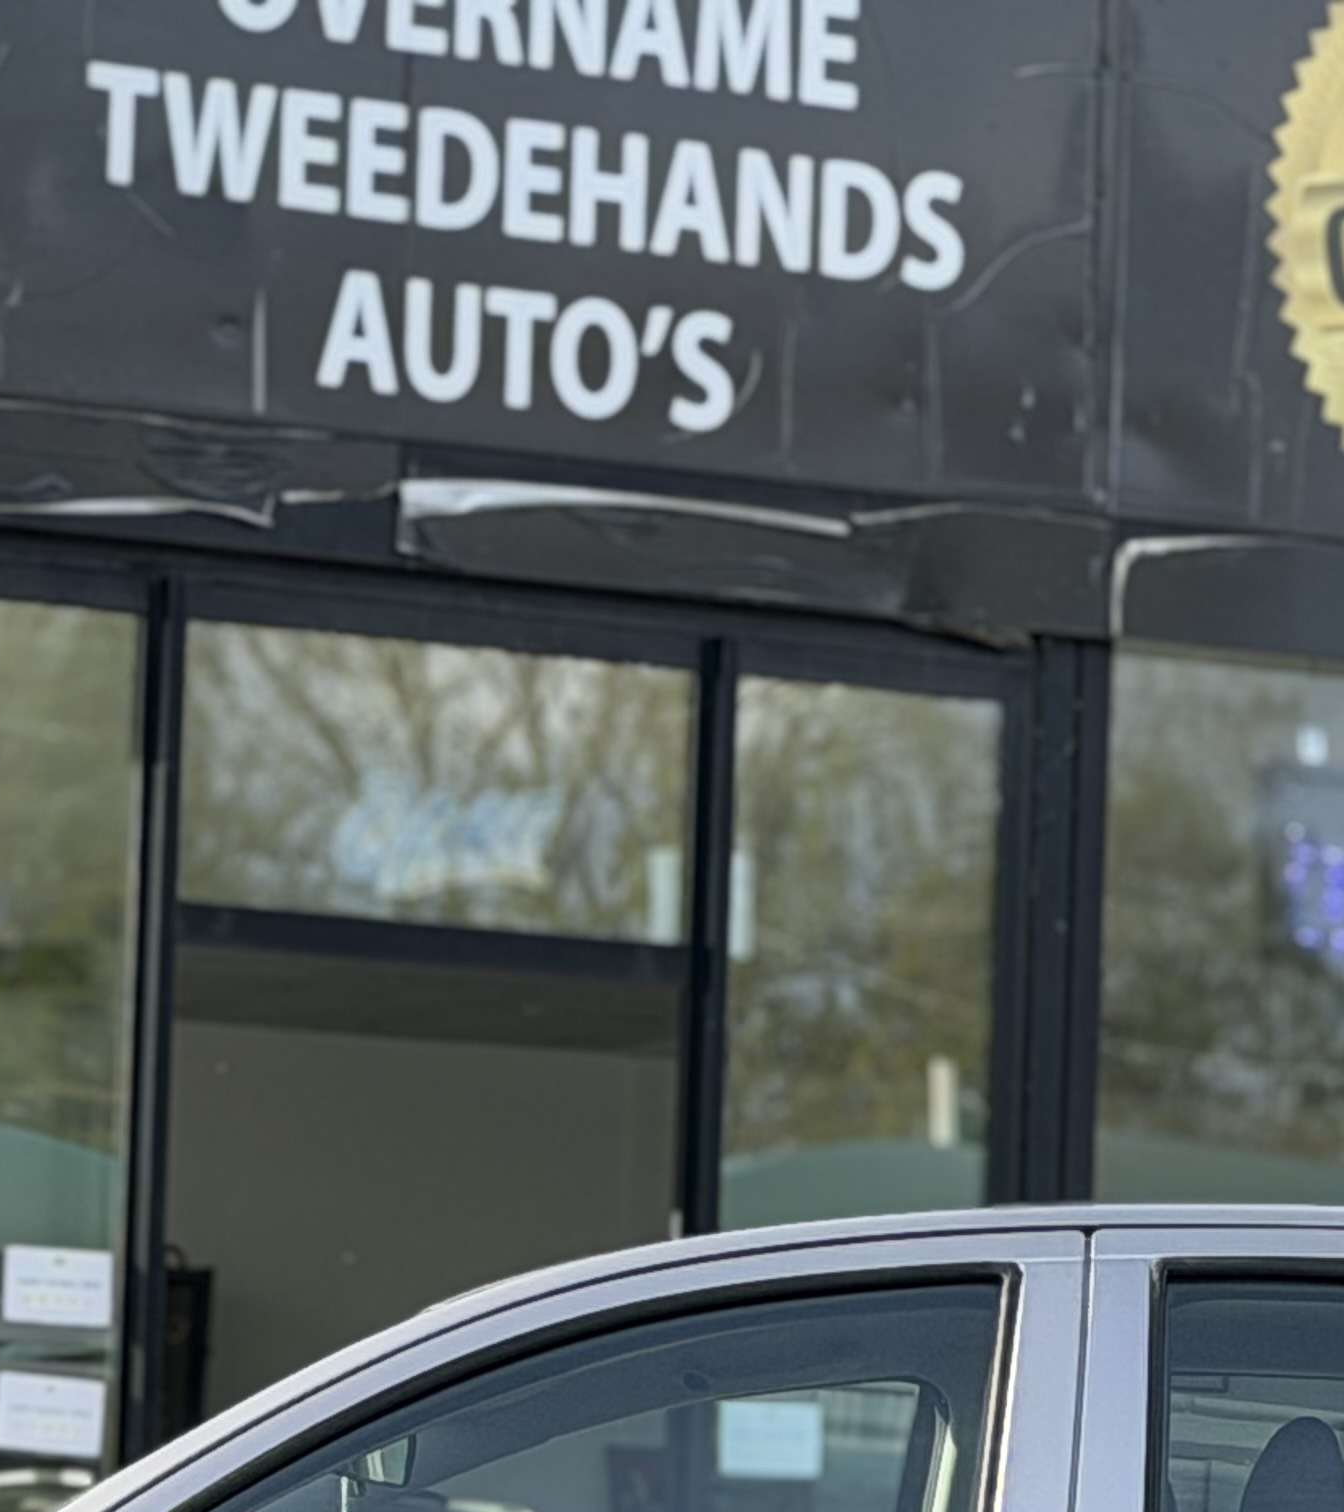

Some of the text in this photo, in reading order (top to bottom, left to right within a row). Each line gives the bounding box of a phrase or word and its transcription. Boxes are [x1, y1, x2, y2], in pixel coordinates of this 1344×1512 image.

[216, 0, 861, 111] RNAME
[86, 60, 965, 291] TWEEDEHANDS
[316, 269, 734, 433] AUTO'S
